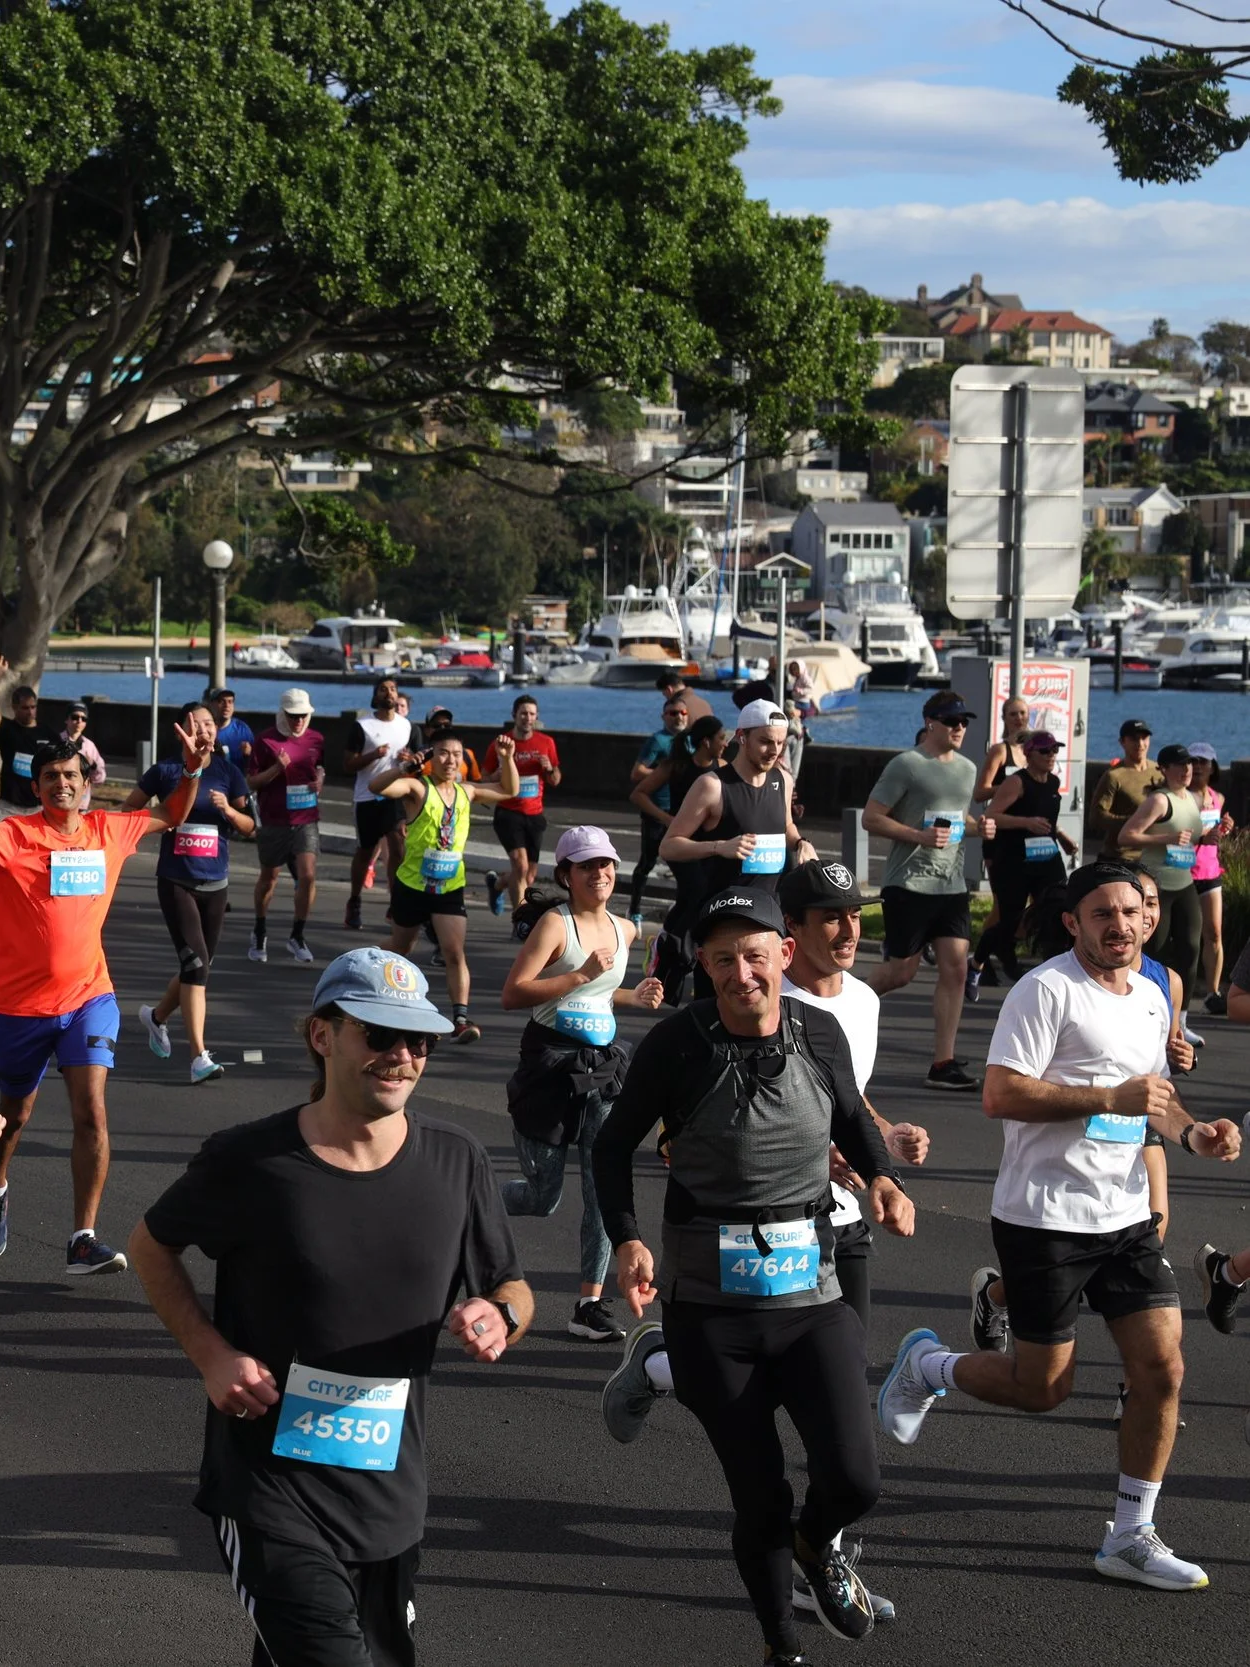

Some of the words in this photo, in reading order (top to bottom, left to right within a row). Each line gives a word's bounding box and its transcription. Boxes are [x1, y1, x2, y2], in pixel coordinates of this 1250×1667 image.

[179, 837, 216, 849] 20407
[59, 870, 100, 884] 41380
[709, 896, 753, 913] Modex
[380, 986, 420, 1001] LAGER
[563, 1016, 610, 1032] 33655
[735, 1231, 803, 1246] CIT2SURF
[731, 1254, 810, 1277] 47644
[307, 1380, 393, 1402] CITY2SURF
[292, 1410, 391, 1446] 45350
[292, 1447, 312, 1457] BLUE
